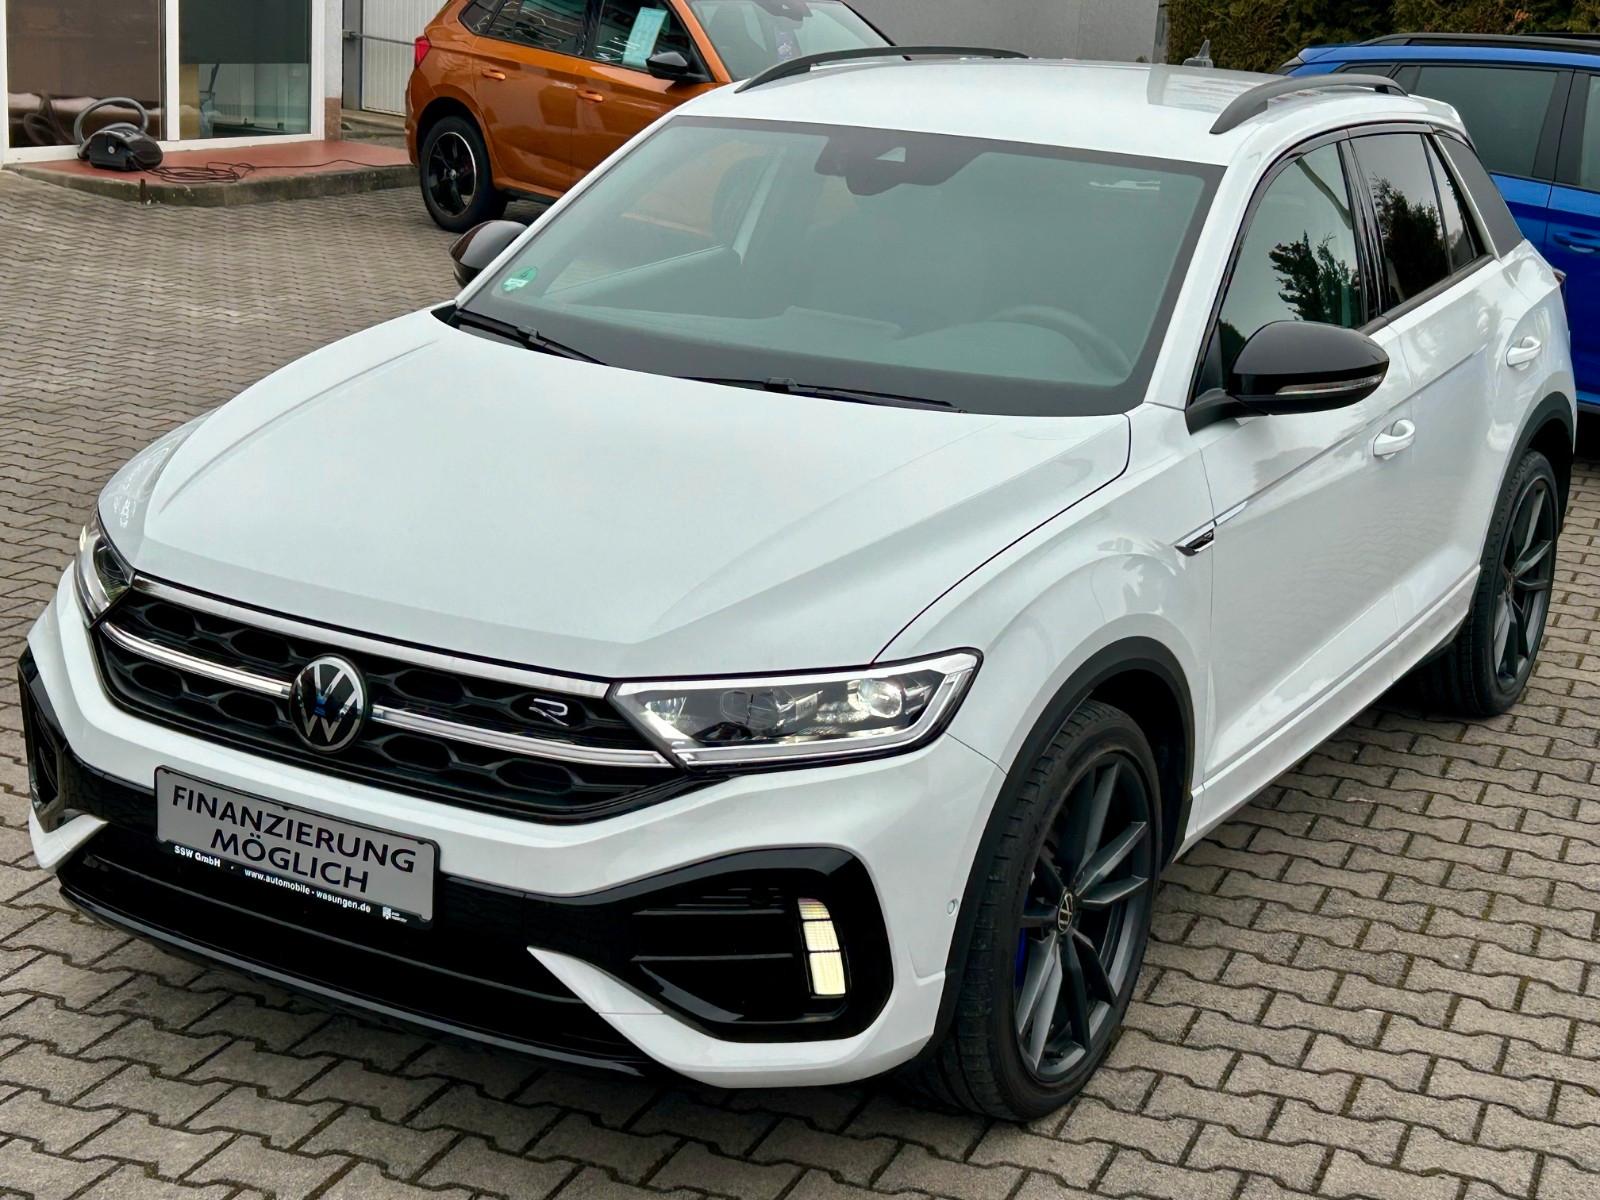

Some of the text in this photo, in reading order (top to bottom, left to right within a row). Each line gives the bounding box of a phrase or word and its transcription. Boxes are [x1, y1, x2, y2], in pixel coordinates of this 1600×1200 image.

[173, 785, 416, 873] FINANZIERUNG
[174, 845, 194, 859] SSW
[195, 853, 221, 868] GmbH
[210, 829, 369, 893] MÖGLICH
